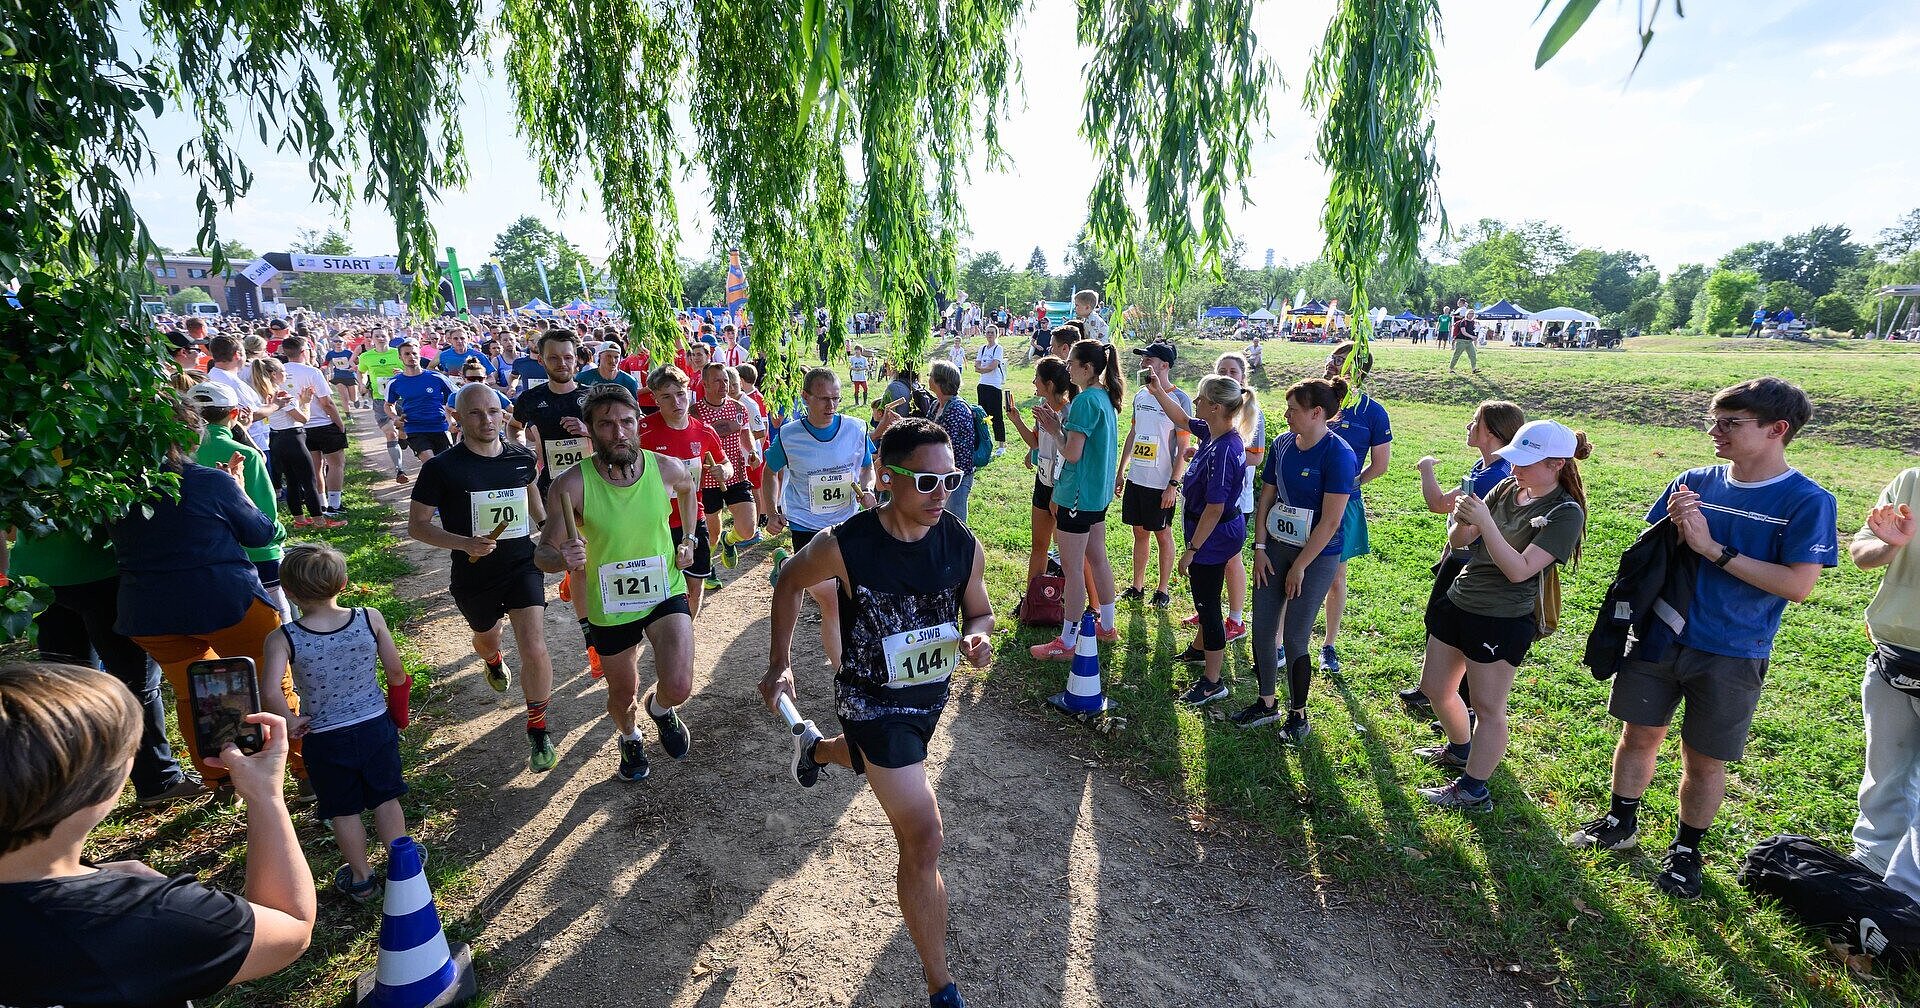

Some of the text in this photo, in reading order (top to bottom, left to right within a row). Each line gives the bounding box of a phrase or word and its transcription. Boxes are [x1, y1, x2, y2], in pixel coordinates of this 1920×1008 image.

[323, 258, 371, 270] START
[1134, 444, 1151, 457] 242
[554, 451, 583, 466] 294
[496, 489, 515, 499] StWB
[823, 487, 841, 502] 84
[490, 506, 515, 524] 70
[1277, 518, 1294, 535] 80
[626, 560, 647, 569] StWB
[613, 575, 651, 596] 121
[916, 627, 941, 642] StWB
[902, 647, 942, 679] 144
